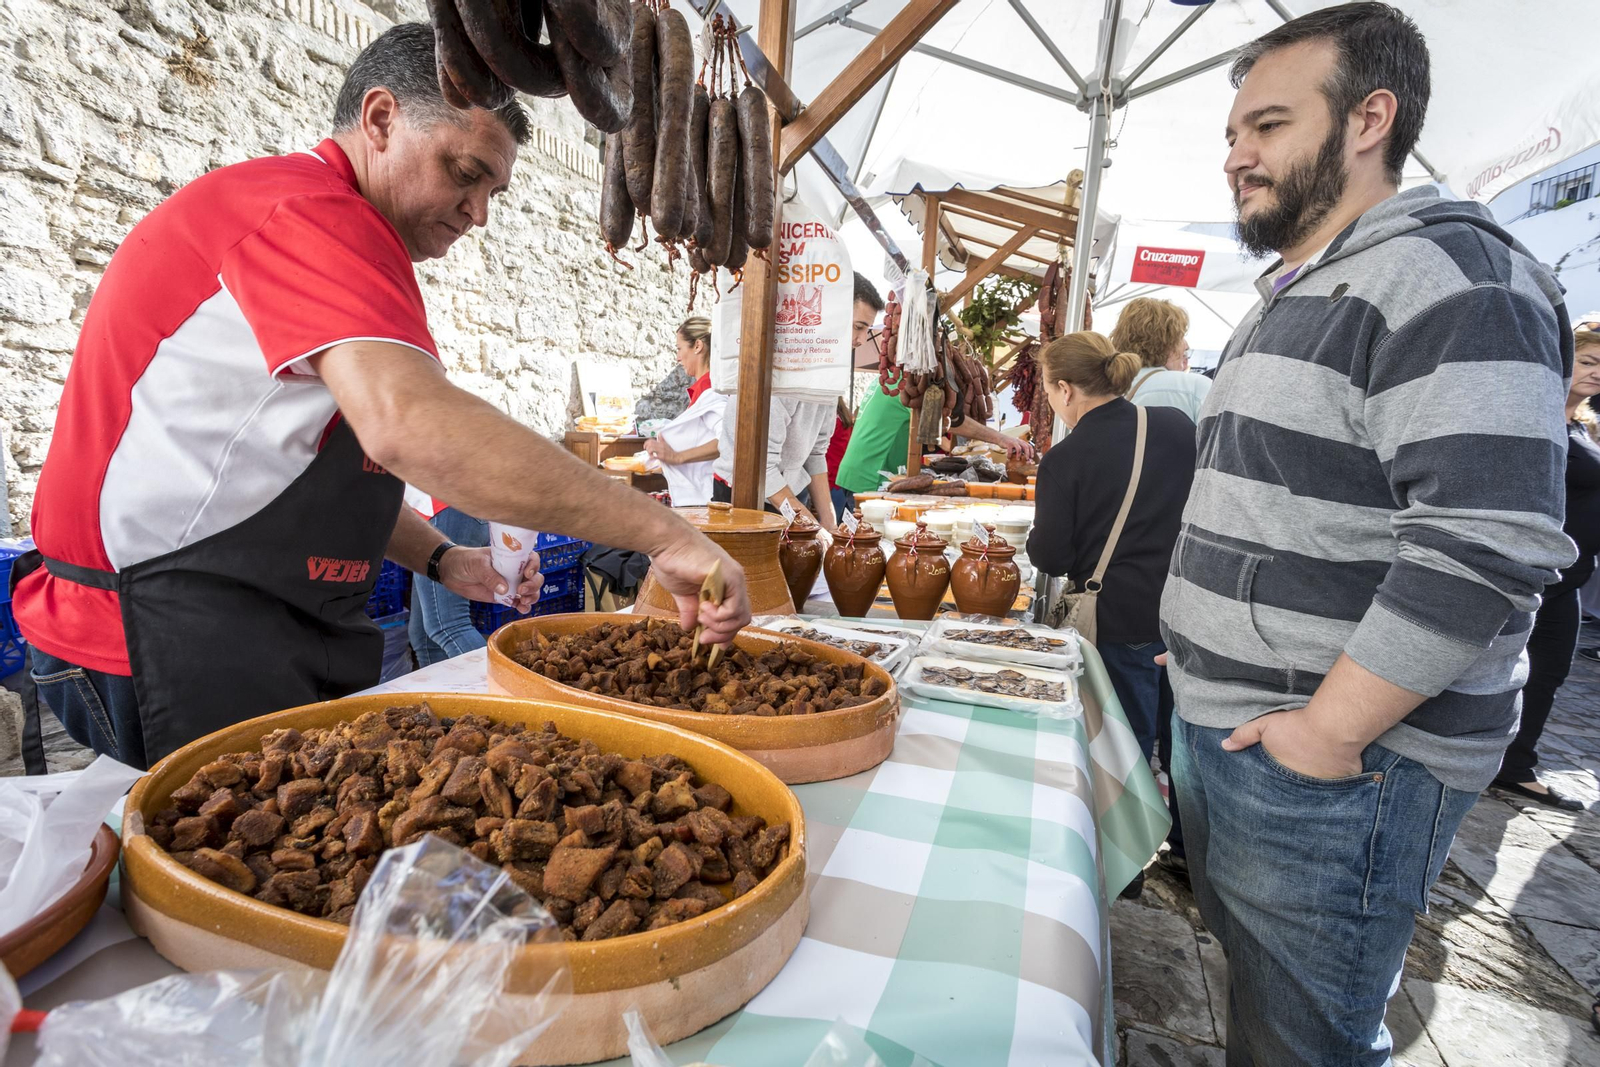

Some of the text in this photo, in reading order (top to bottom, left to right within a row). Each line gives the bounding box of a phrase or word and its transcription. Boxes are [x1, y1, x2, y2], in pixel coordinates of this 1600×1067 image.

[1140, 249, 1199, 266] Cruzcampo
[307, 556, 363, 566] AYUNTAMIENTO
[307, 559, 370, 582] VEJER
